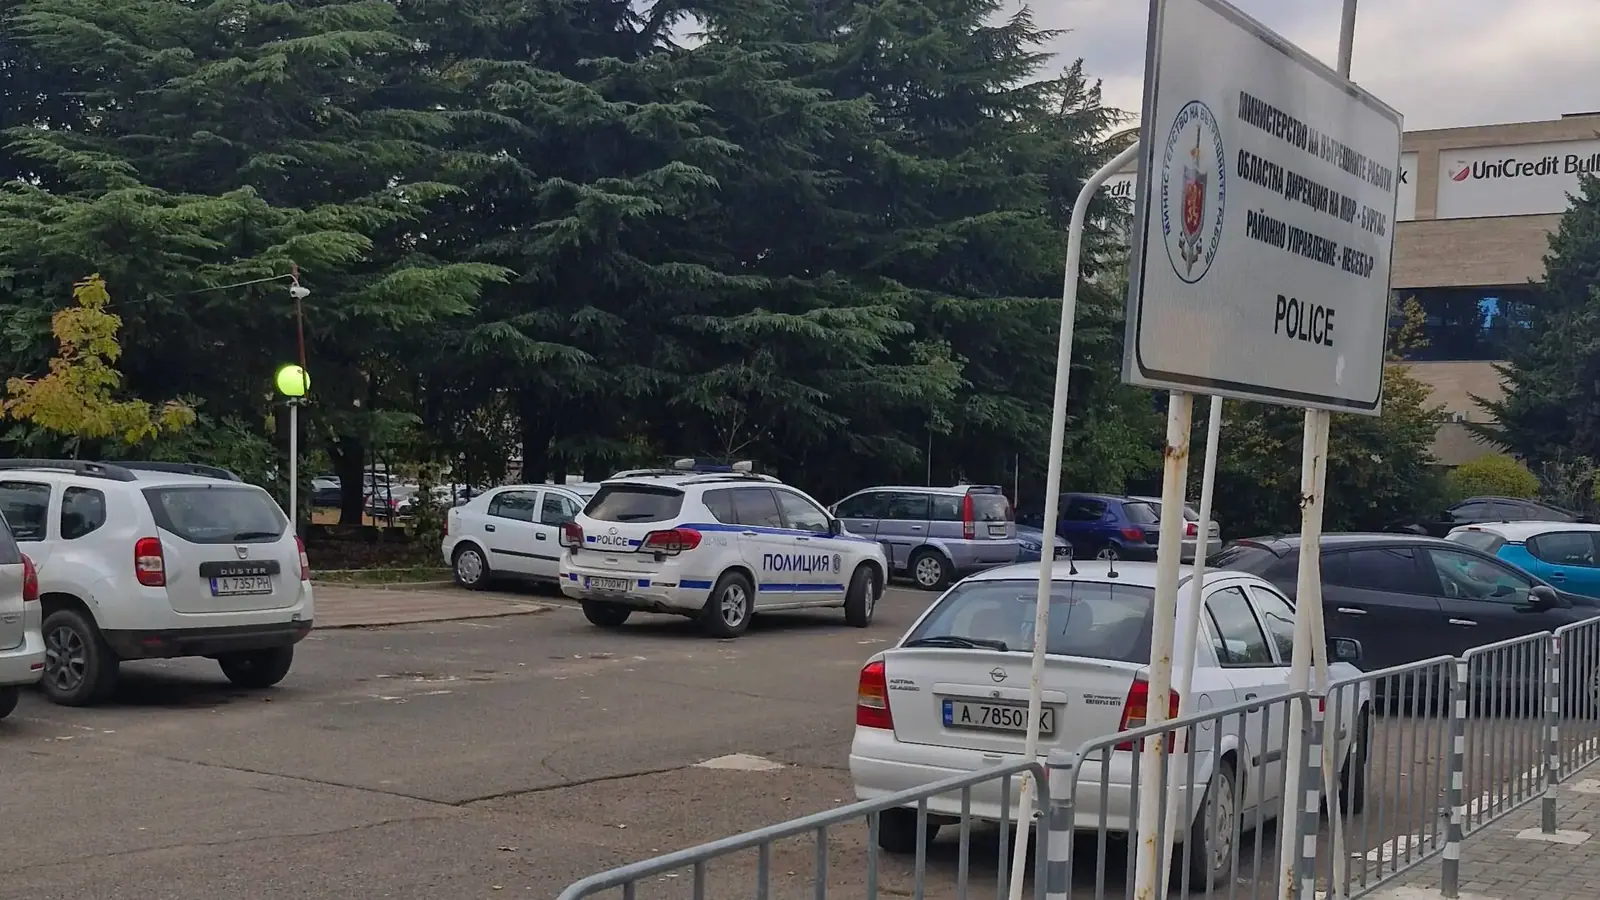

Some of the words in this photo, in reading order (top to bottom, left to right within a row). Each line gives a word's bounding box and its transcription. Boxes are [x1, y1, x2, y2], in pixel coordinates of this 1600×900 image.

[1238, 91, 1308, 150] МИНИСТЕРСТВО
[1308, 127, 1319, 157] НА
[1367, 158, 1393, 193] РАБОТИ
[1472, 155, 1560, 180] UniCredit
[1237, 148, 1284, 195] ОБЛАСТНА
[1284, 170, 1329, 213] ДИРЕКЦИЯ
[1328, 189, 1339, 218] НА
[1340, 195, 1357, 224] МВР
[1361, 205, 1387, 237] БУРГАС
[1246, 208, 1286, 249] РАЙОННО
[1287, 225, 1338, 267] УПРАВЛЕНИЕ
[1341, 246, 1374, 279] НЕСЕБЪР
[1274, 294, 1335, 347] POLICE
[596, 535, 628, 547] POLICE
[220, 567, 267, 575] DUSTER
[763, 553, 829, 575] ПОЛИЦИЯ
